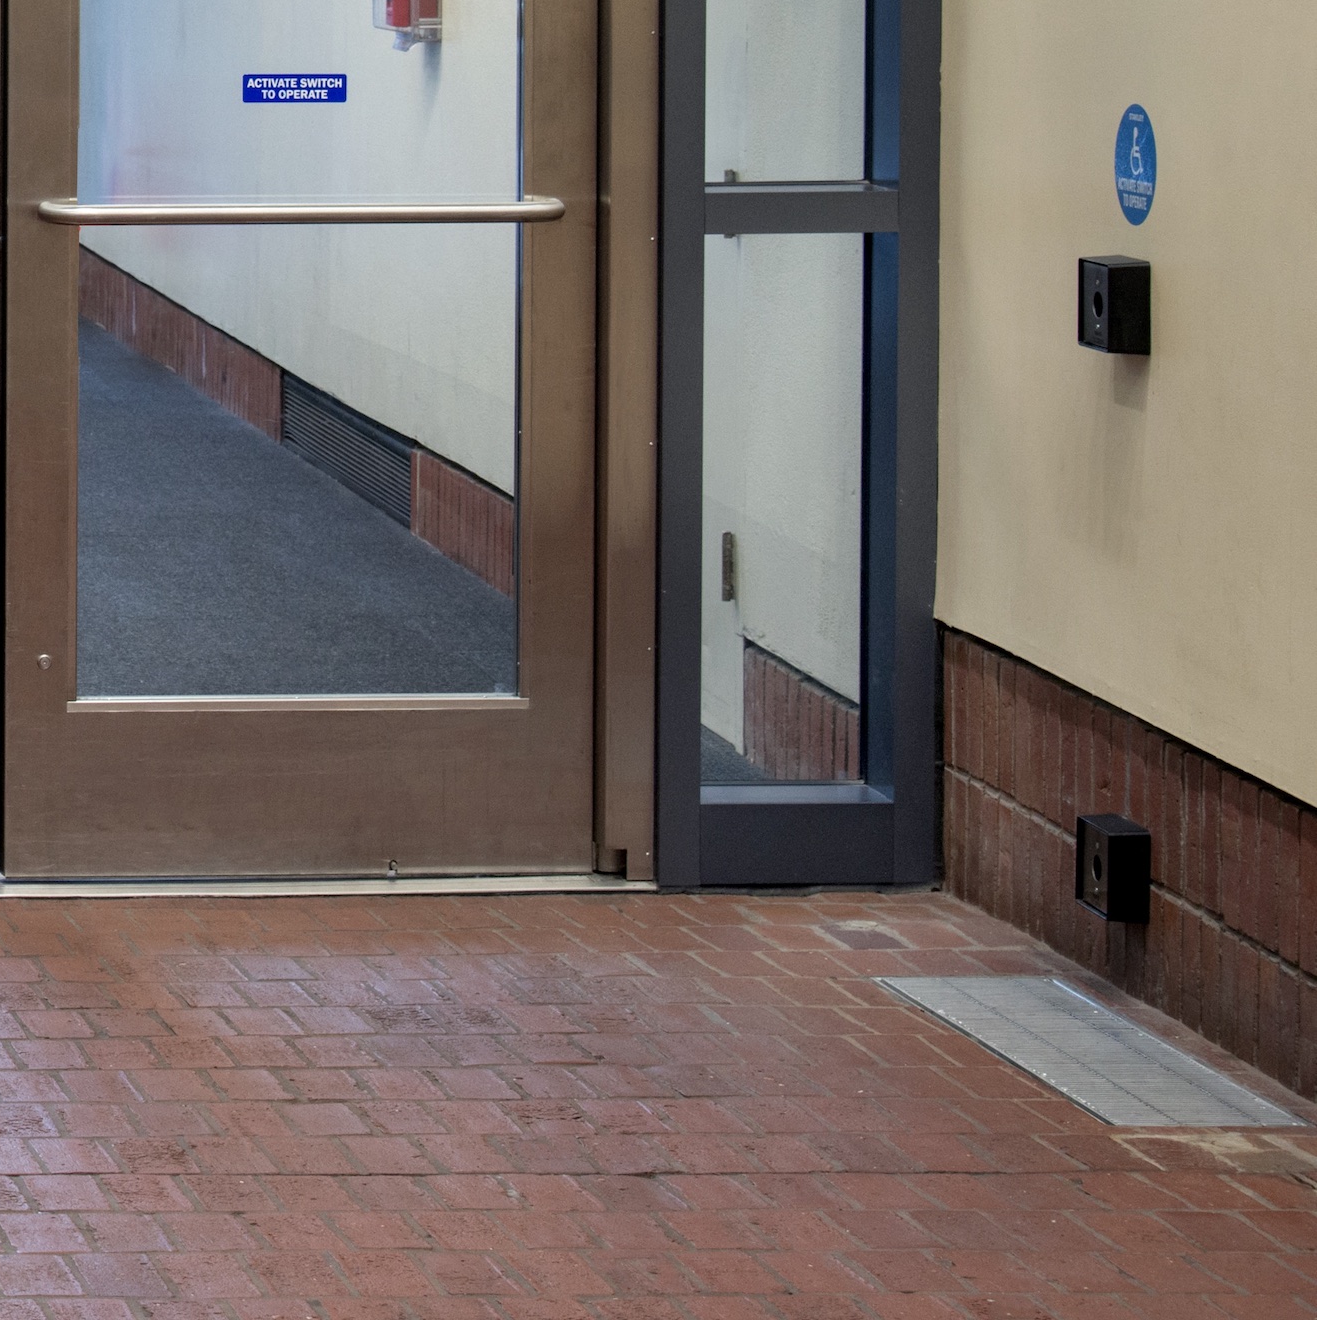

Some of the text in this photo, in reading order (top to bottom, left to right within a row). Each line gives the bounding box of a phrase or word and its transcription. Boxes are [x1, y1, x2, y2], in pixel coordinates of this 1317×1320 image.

[247, 77, 343, 88] ACTIVATE SWITCH
[261, 89, 328, 100] TO OPERATE
[1117, 177, 1154, 196] ACTIVATE SWITCH
[1122, 193, 1148, 211] TO OPERATE
